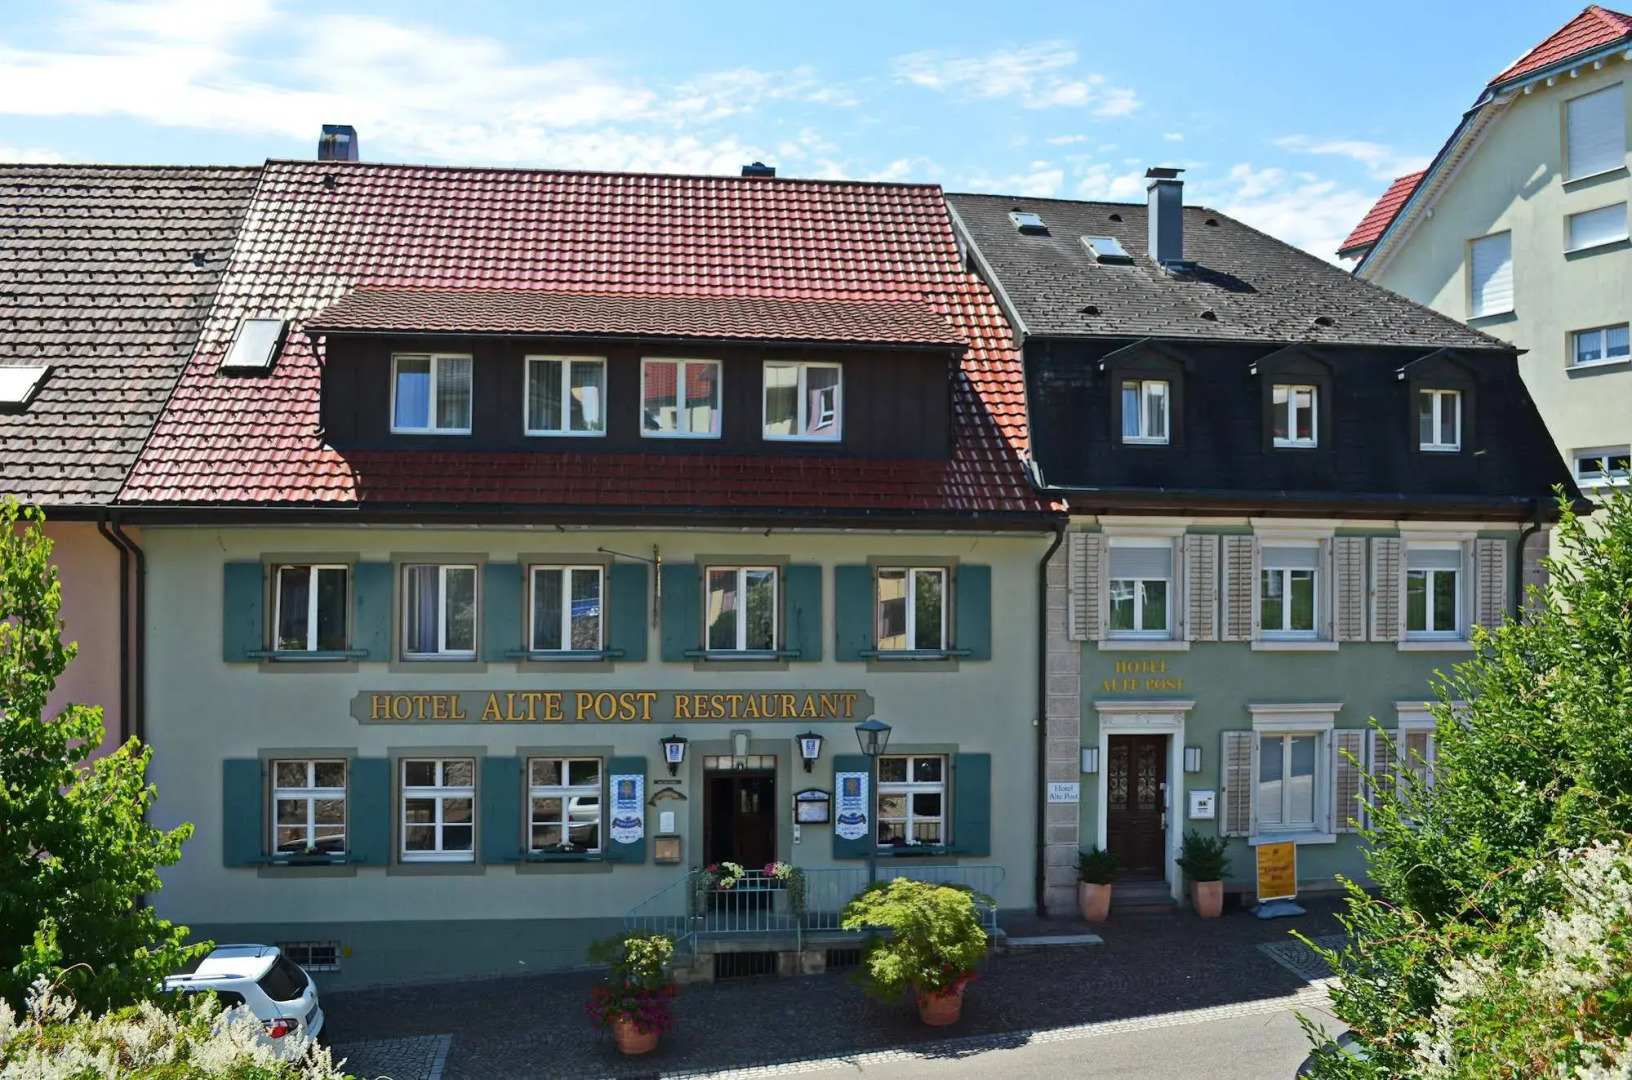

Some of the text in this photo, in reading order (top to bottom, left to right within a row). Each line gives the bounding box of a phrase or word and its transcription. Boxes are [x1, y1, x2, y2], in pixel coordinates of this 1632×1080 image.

[1115, 660, 1171, 673] HOTEL
[1099, 677, 1186, 692] ALTE POST
[370, 691, 857, 722] HOTEL ALTE POST RESTAURANT
[1054, 784, 1074, 792] Hotel
